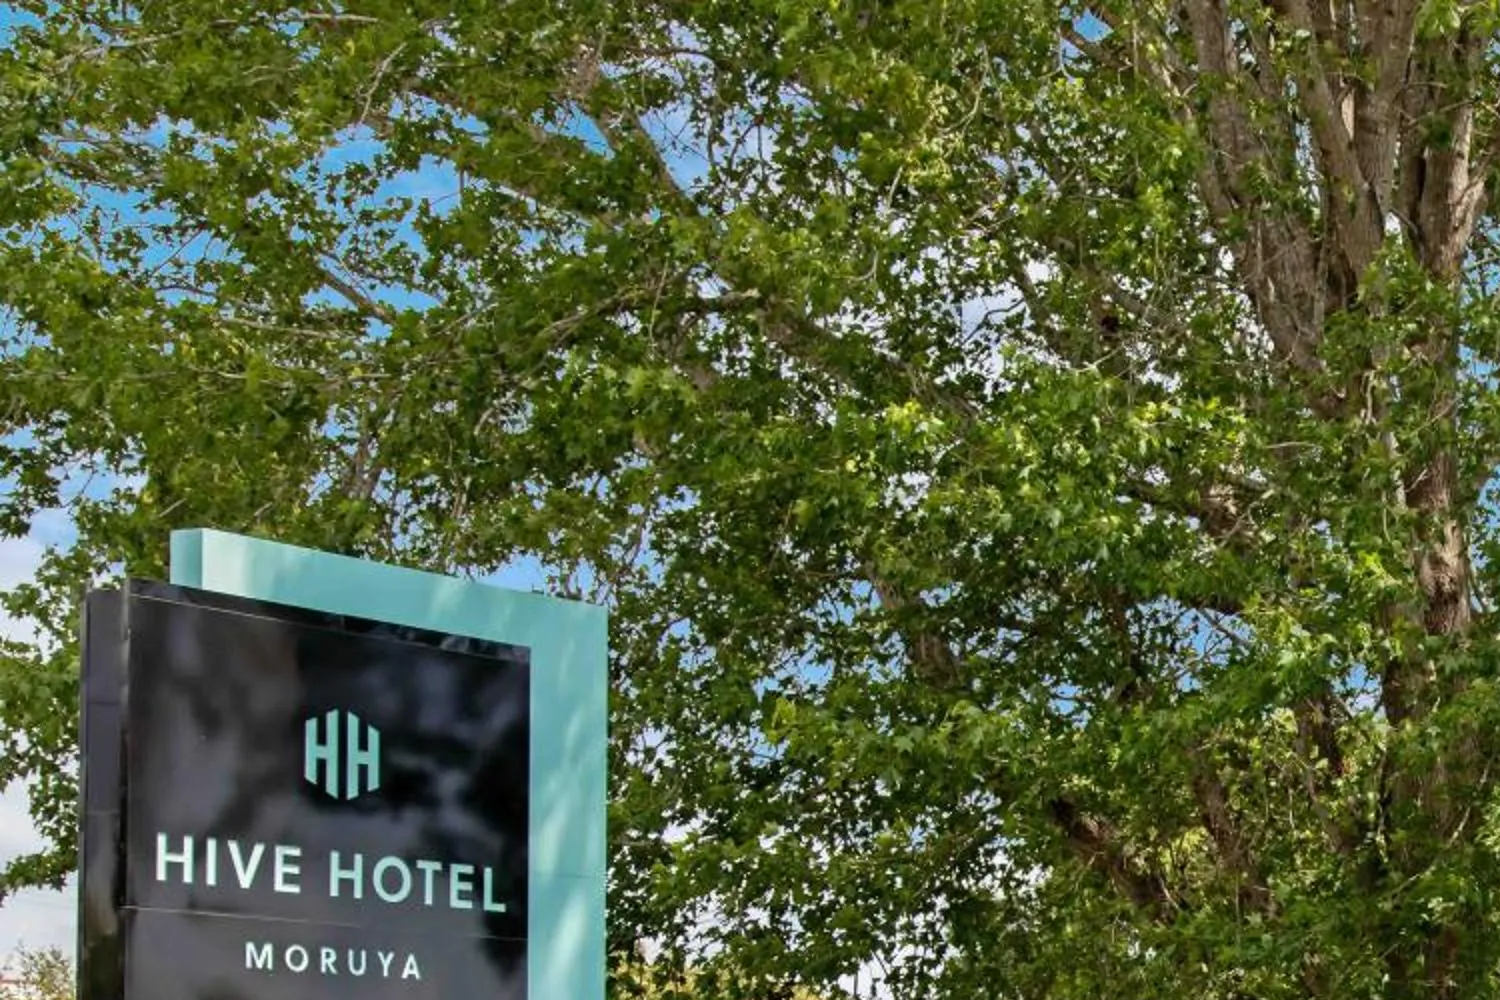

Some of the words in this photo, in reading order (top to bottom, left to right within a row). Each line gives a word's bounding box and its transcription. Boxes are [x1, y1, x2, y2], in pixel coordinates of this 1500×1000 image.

[304, 708, 380, 800] HH
[155, 832, 302, 894] HIVE
[329, 850, 506, 913] HOTEL
[245, 942, 420, 980] MORUYA
